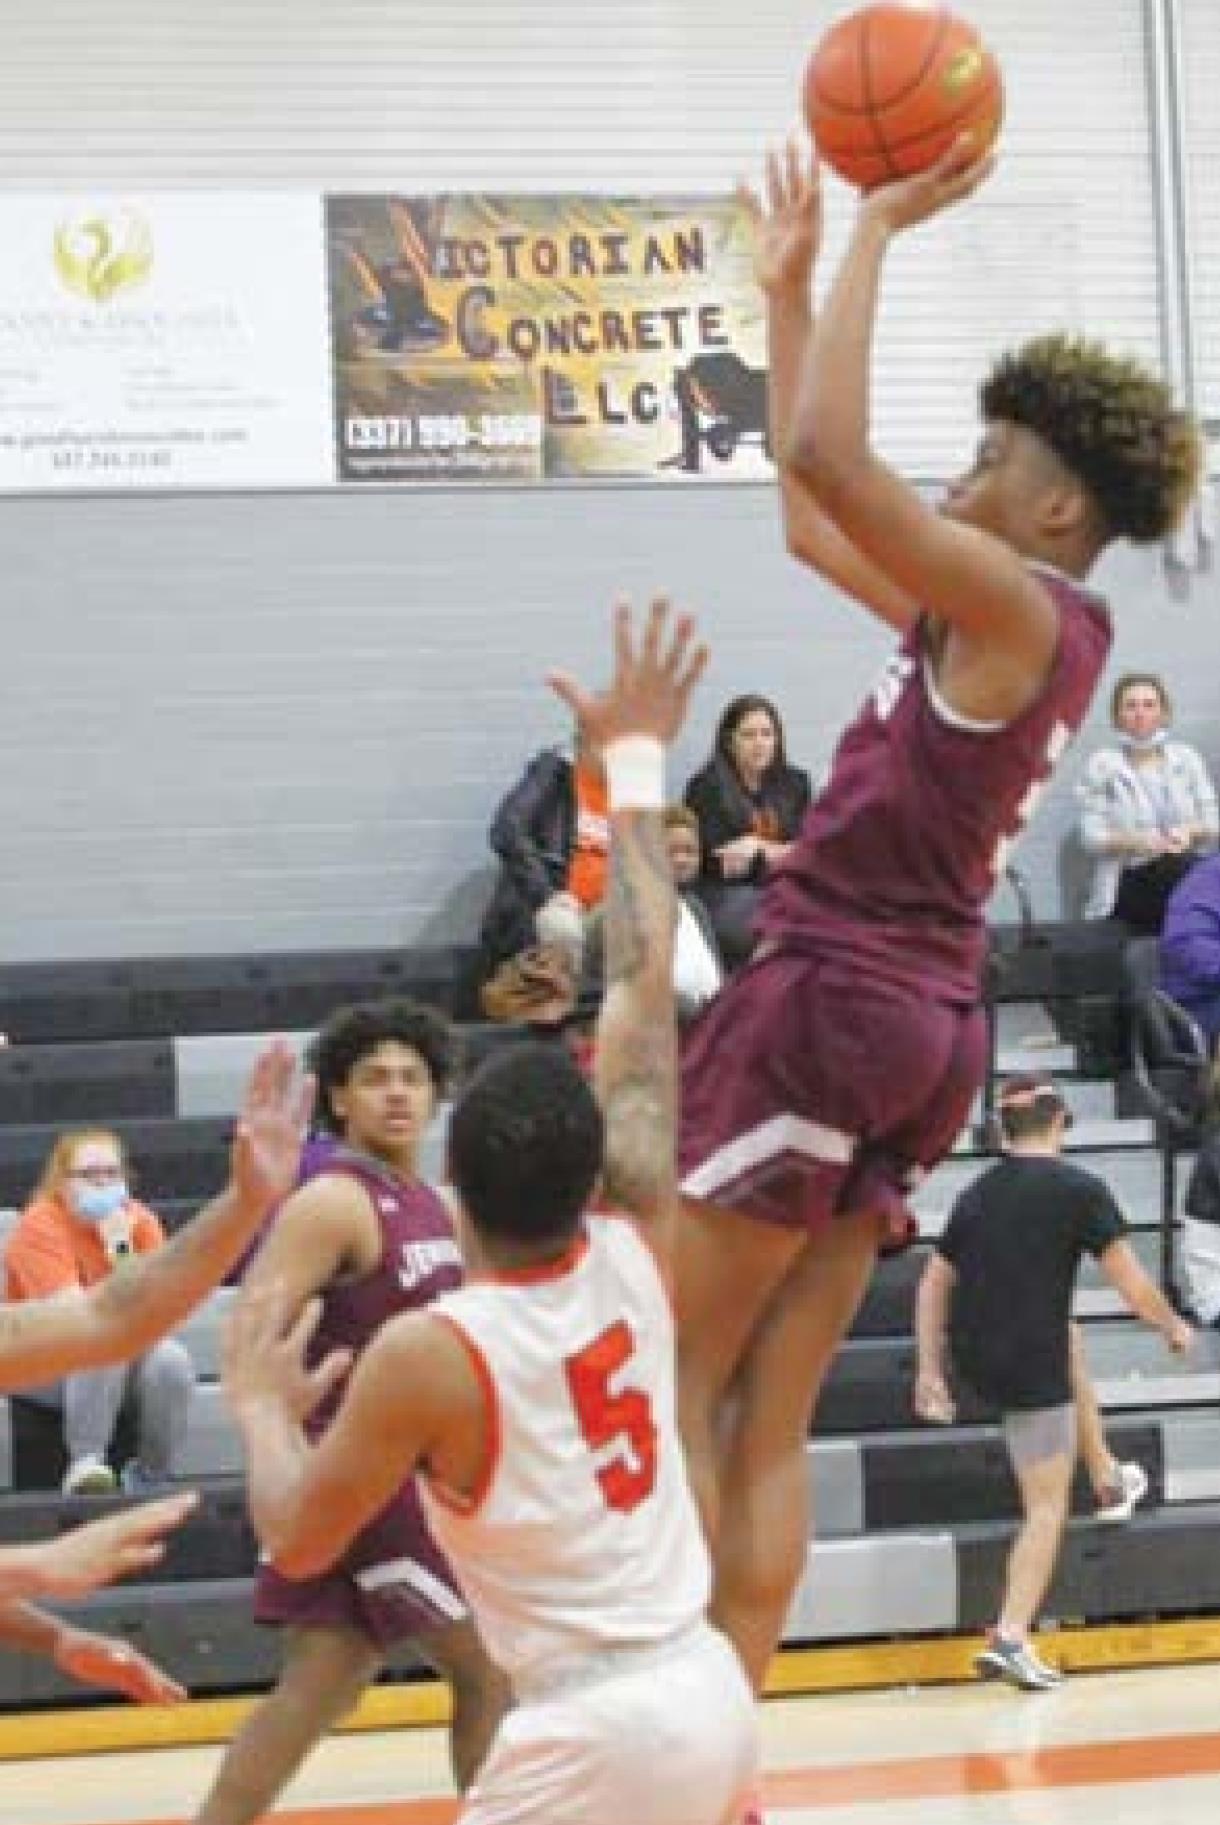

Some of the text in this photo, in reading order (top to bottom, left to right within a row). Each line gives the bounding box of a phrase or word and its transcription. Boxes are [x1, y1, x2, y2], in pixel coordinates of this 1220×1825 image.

[456, 287, 729, 360] CONCRETE
[542, 366, 660, 425] LLC
[566, 1319, 657, 1513] 5
